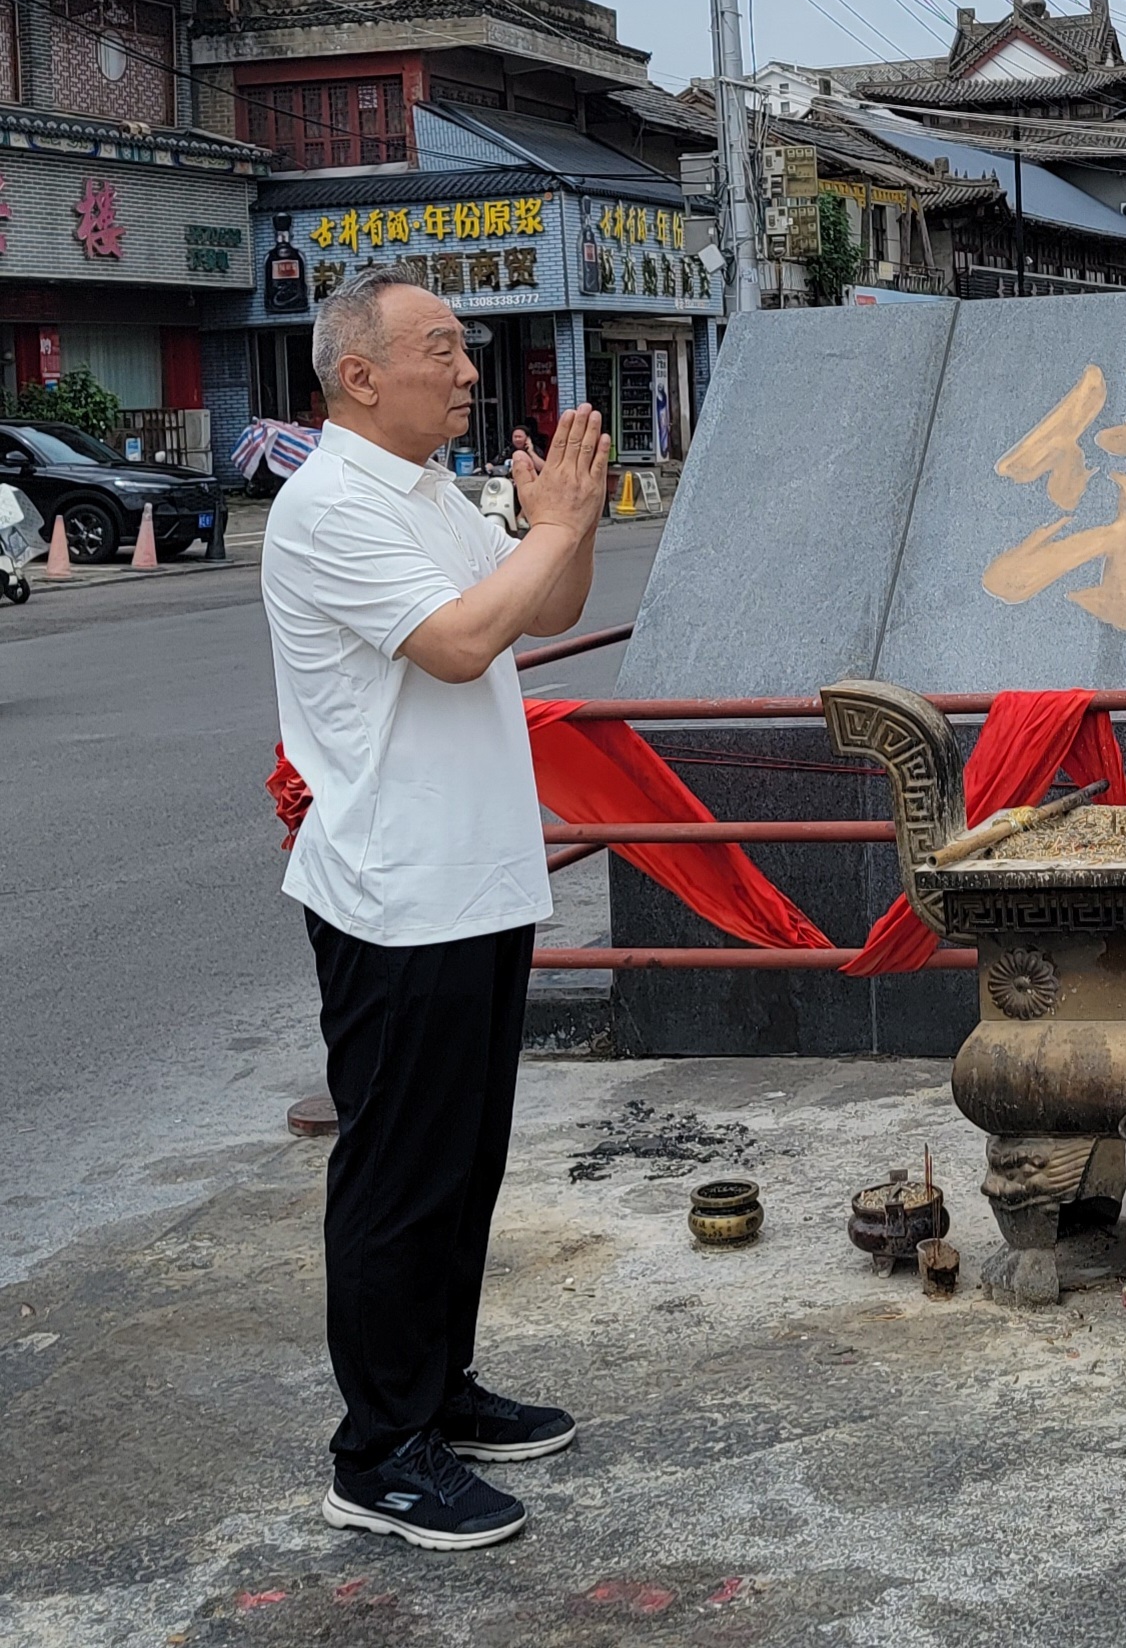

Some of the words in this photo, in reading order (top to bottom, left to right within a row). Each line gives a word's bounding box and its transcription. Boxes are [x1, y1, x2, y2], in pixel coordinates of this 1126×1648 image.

[74, 177, 126, 260] 楼
[312, 246, 538, 303] 赵酒商贸
